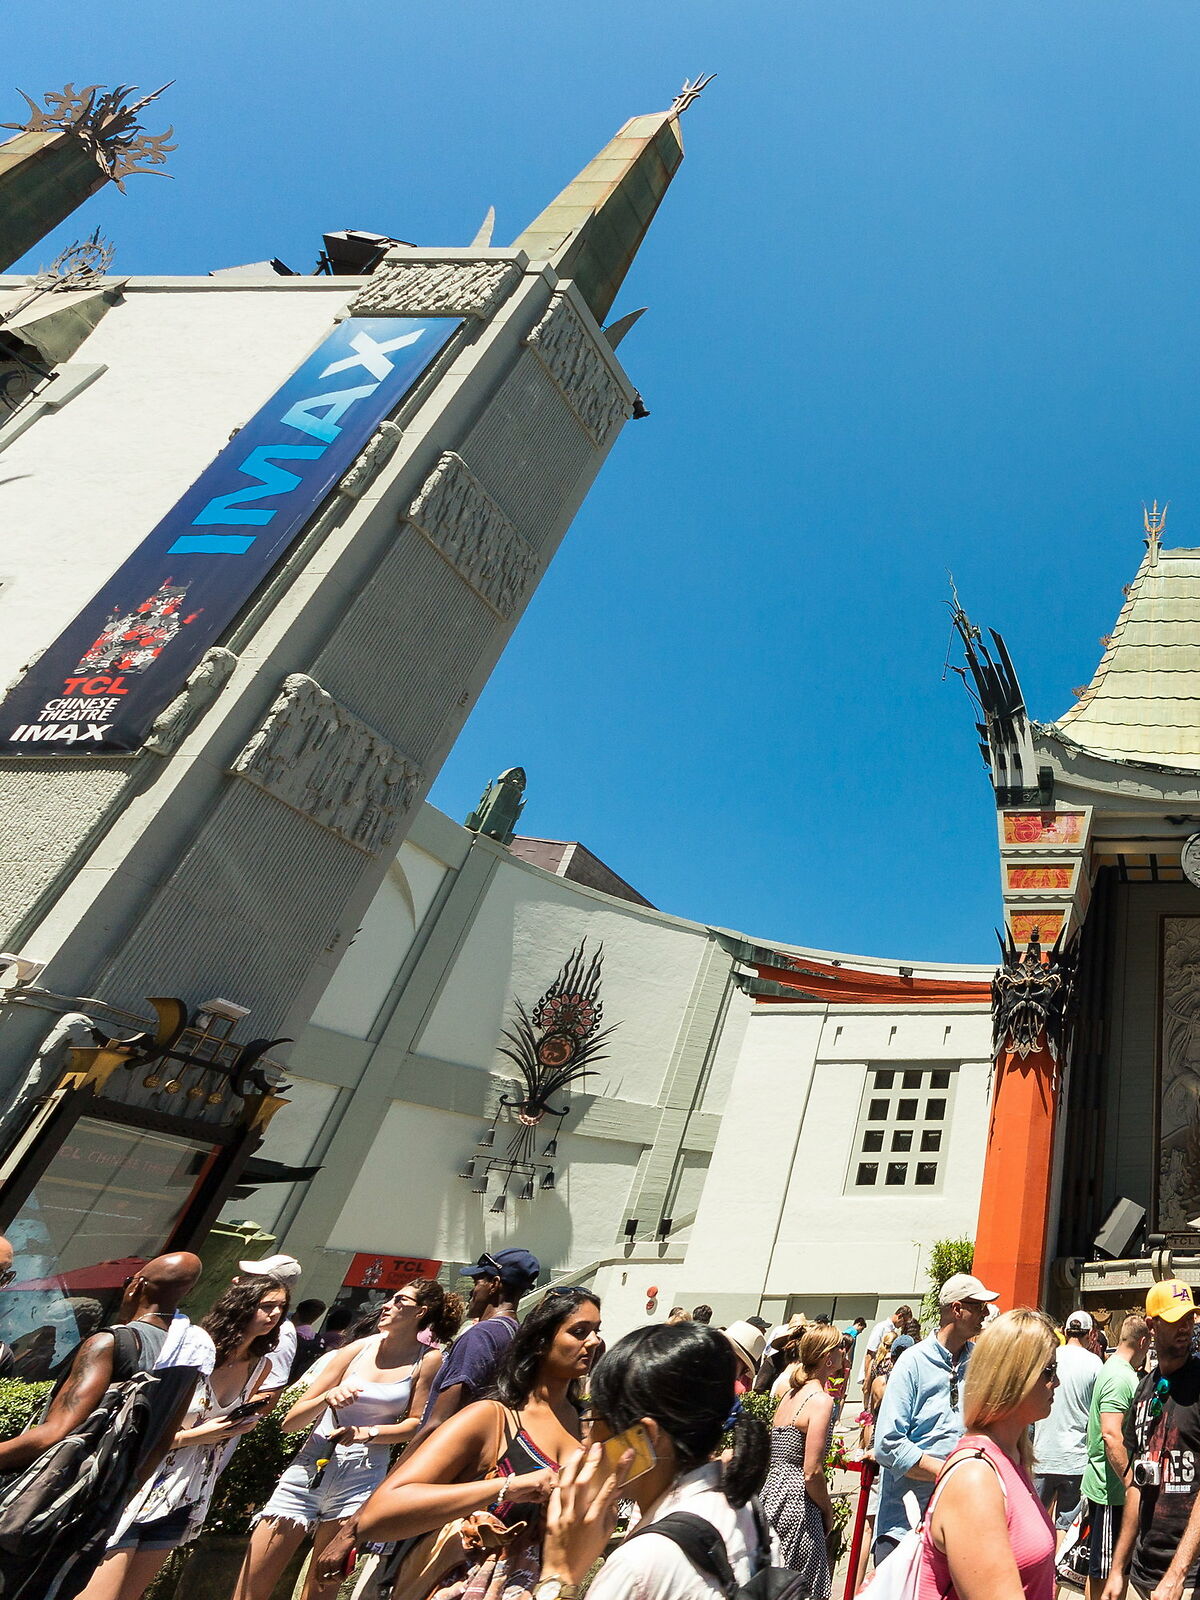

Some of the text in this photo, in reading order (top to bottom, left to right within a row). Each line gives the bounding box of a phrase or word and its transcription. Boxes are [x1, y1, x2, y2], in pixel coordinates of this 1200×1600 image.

[167, 327, 426, 554] IMAX
[63, 676, 129, 695] TCL
[45, 697, 121, 710] CHINESE
[37, 709, 113, 721] THEATRE
[8, 723, 114, 742] IMAX
[1173, 1237, 1195, 1246] TCL
[393, 1260, 425, 1273] TCL
[1172, 1284, 1191, 1301] LA
